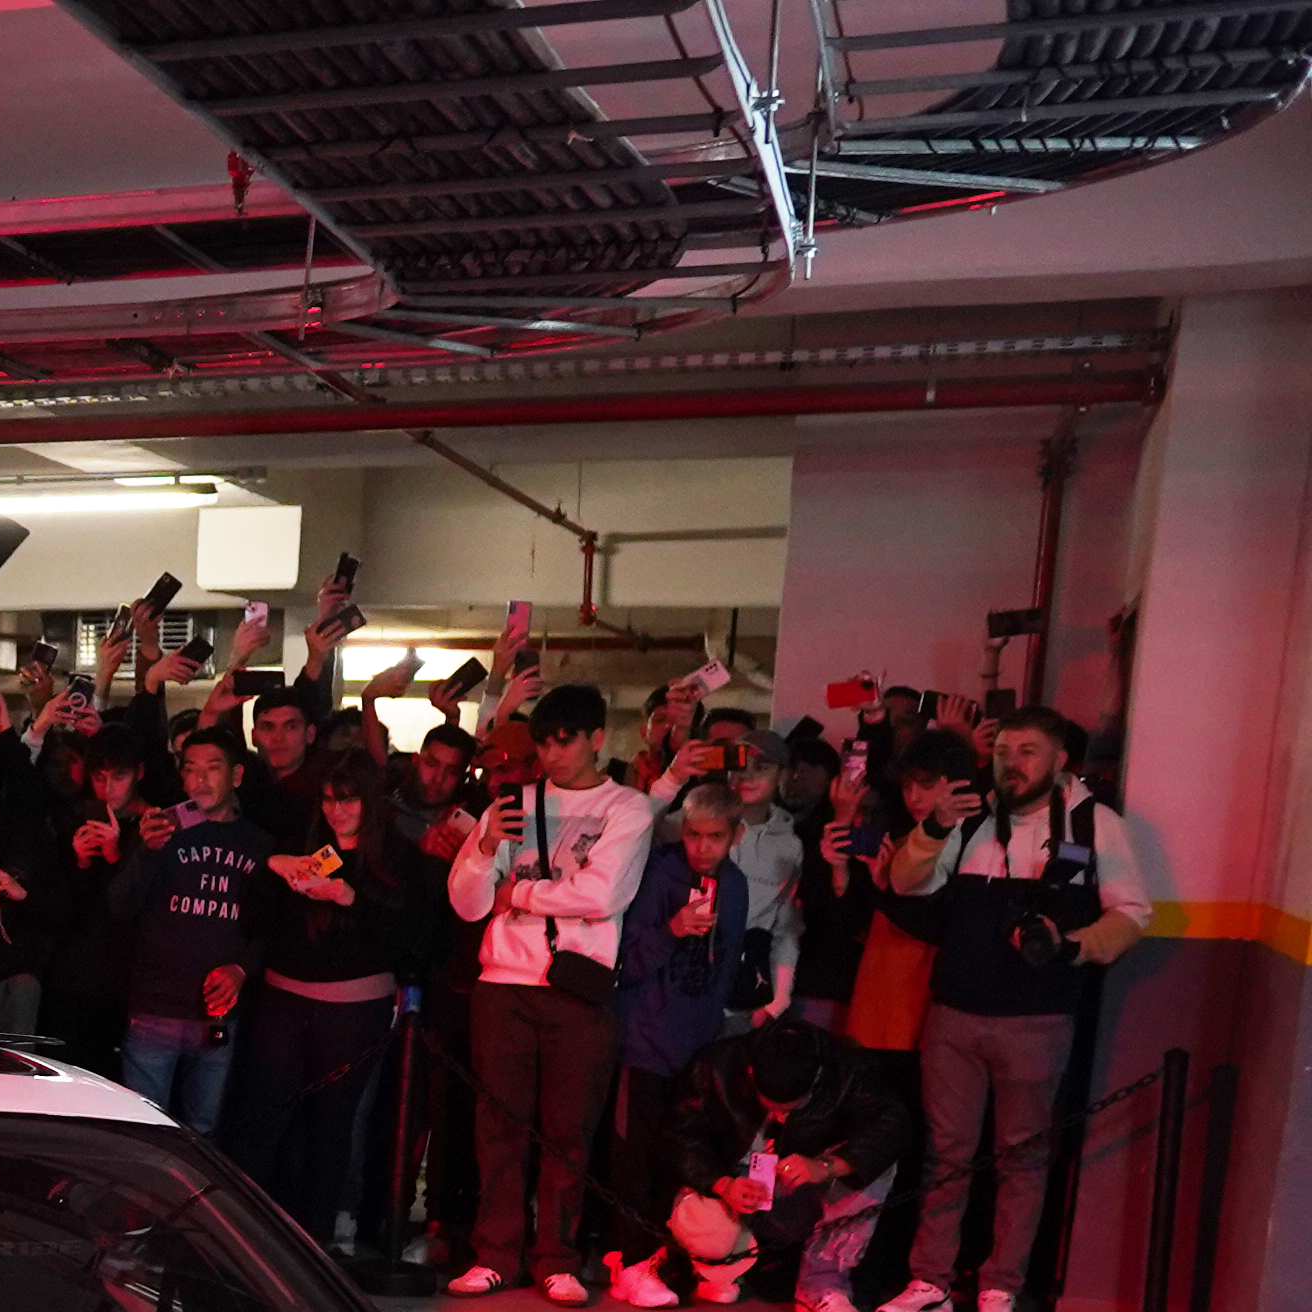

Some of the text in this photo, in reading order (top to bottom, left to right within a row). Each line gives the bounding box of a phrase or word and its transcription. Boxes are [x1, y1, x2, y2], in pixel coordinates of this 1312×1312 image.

[177, 846, 256, 874] CAPTAIN
[200, 873, 229, 893] FIN
[169, 895, 240, 920] COMPAN
